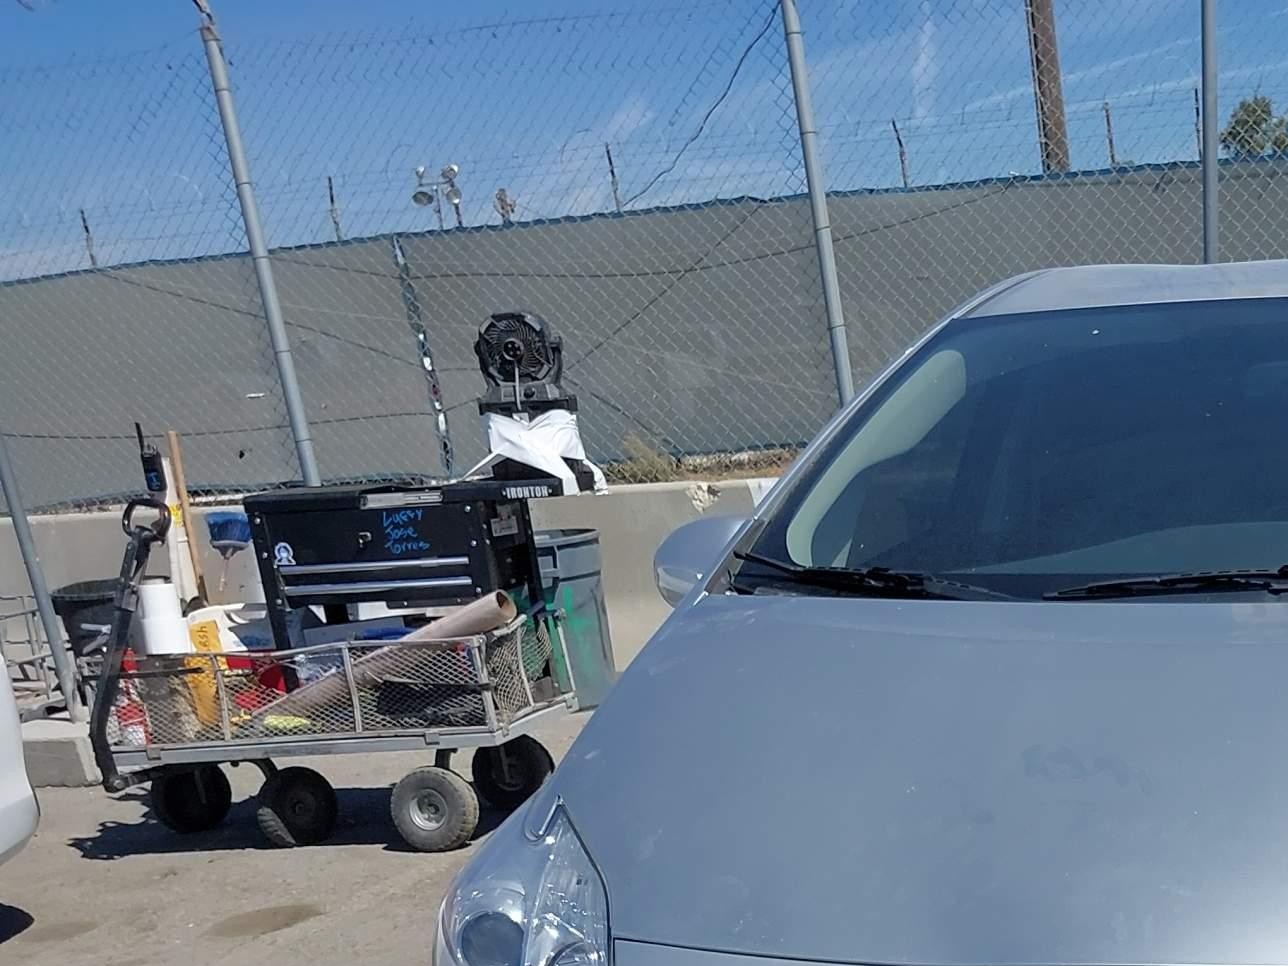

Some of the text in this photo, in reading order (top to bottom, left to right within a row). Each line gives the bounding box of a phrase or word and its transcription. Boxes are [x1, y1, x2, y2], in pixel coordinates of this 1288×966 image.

[505, 485, 549, 499] IRONTON
[384, 525, 418, 540] Jose
[384, 540, 430, 554] Torres
